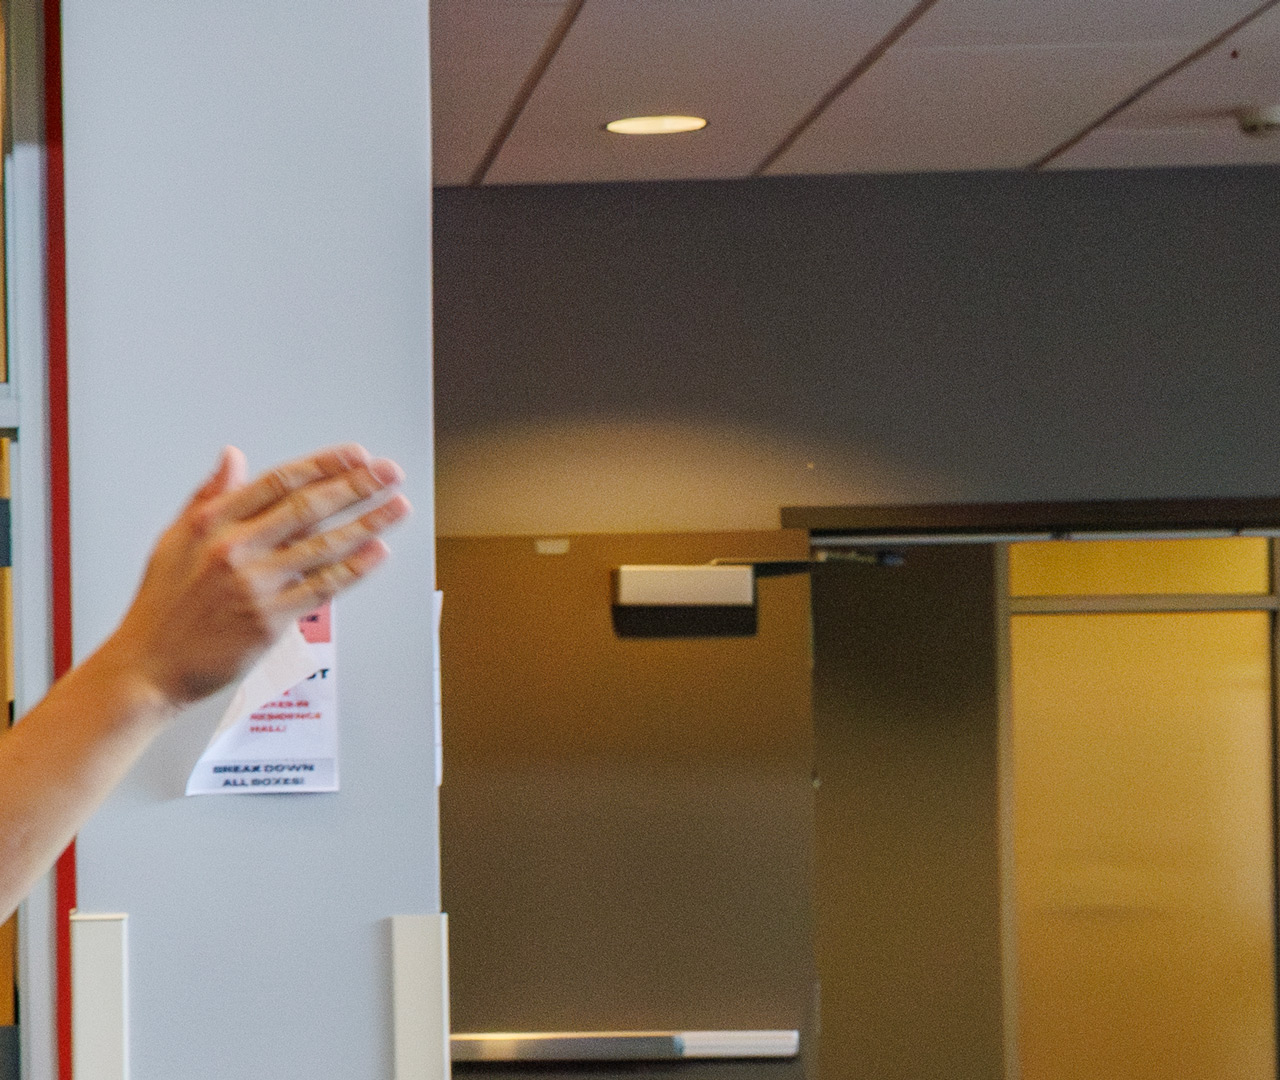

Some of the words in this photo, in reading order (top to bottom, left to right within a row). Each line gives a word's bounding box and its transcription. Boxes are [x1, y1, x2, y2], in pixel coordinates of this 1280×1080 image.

[213, 764, 261, 773] BREAK
[264, 763, 314, 772] DOWN
[223, 778, 248, 786] ALL
